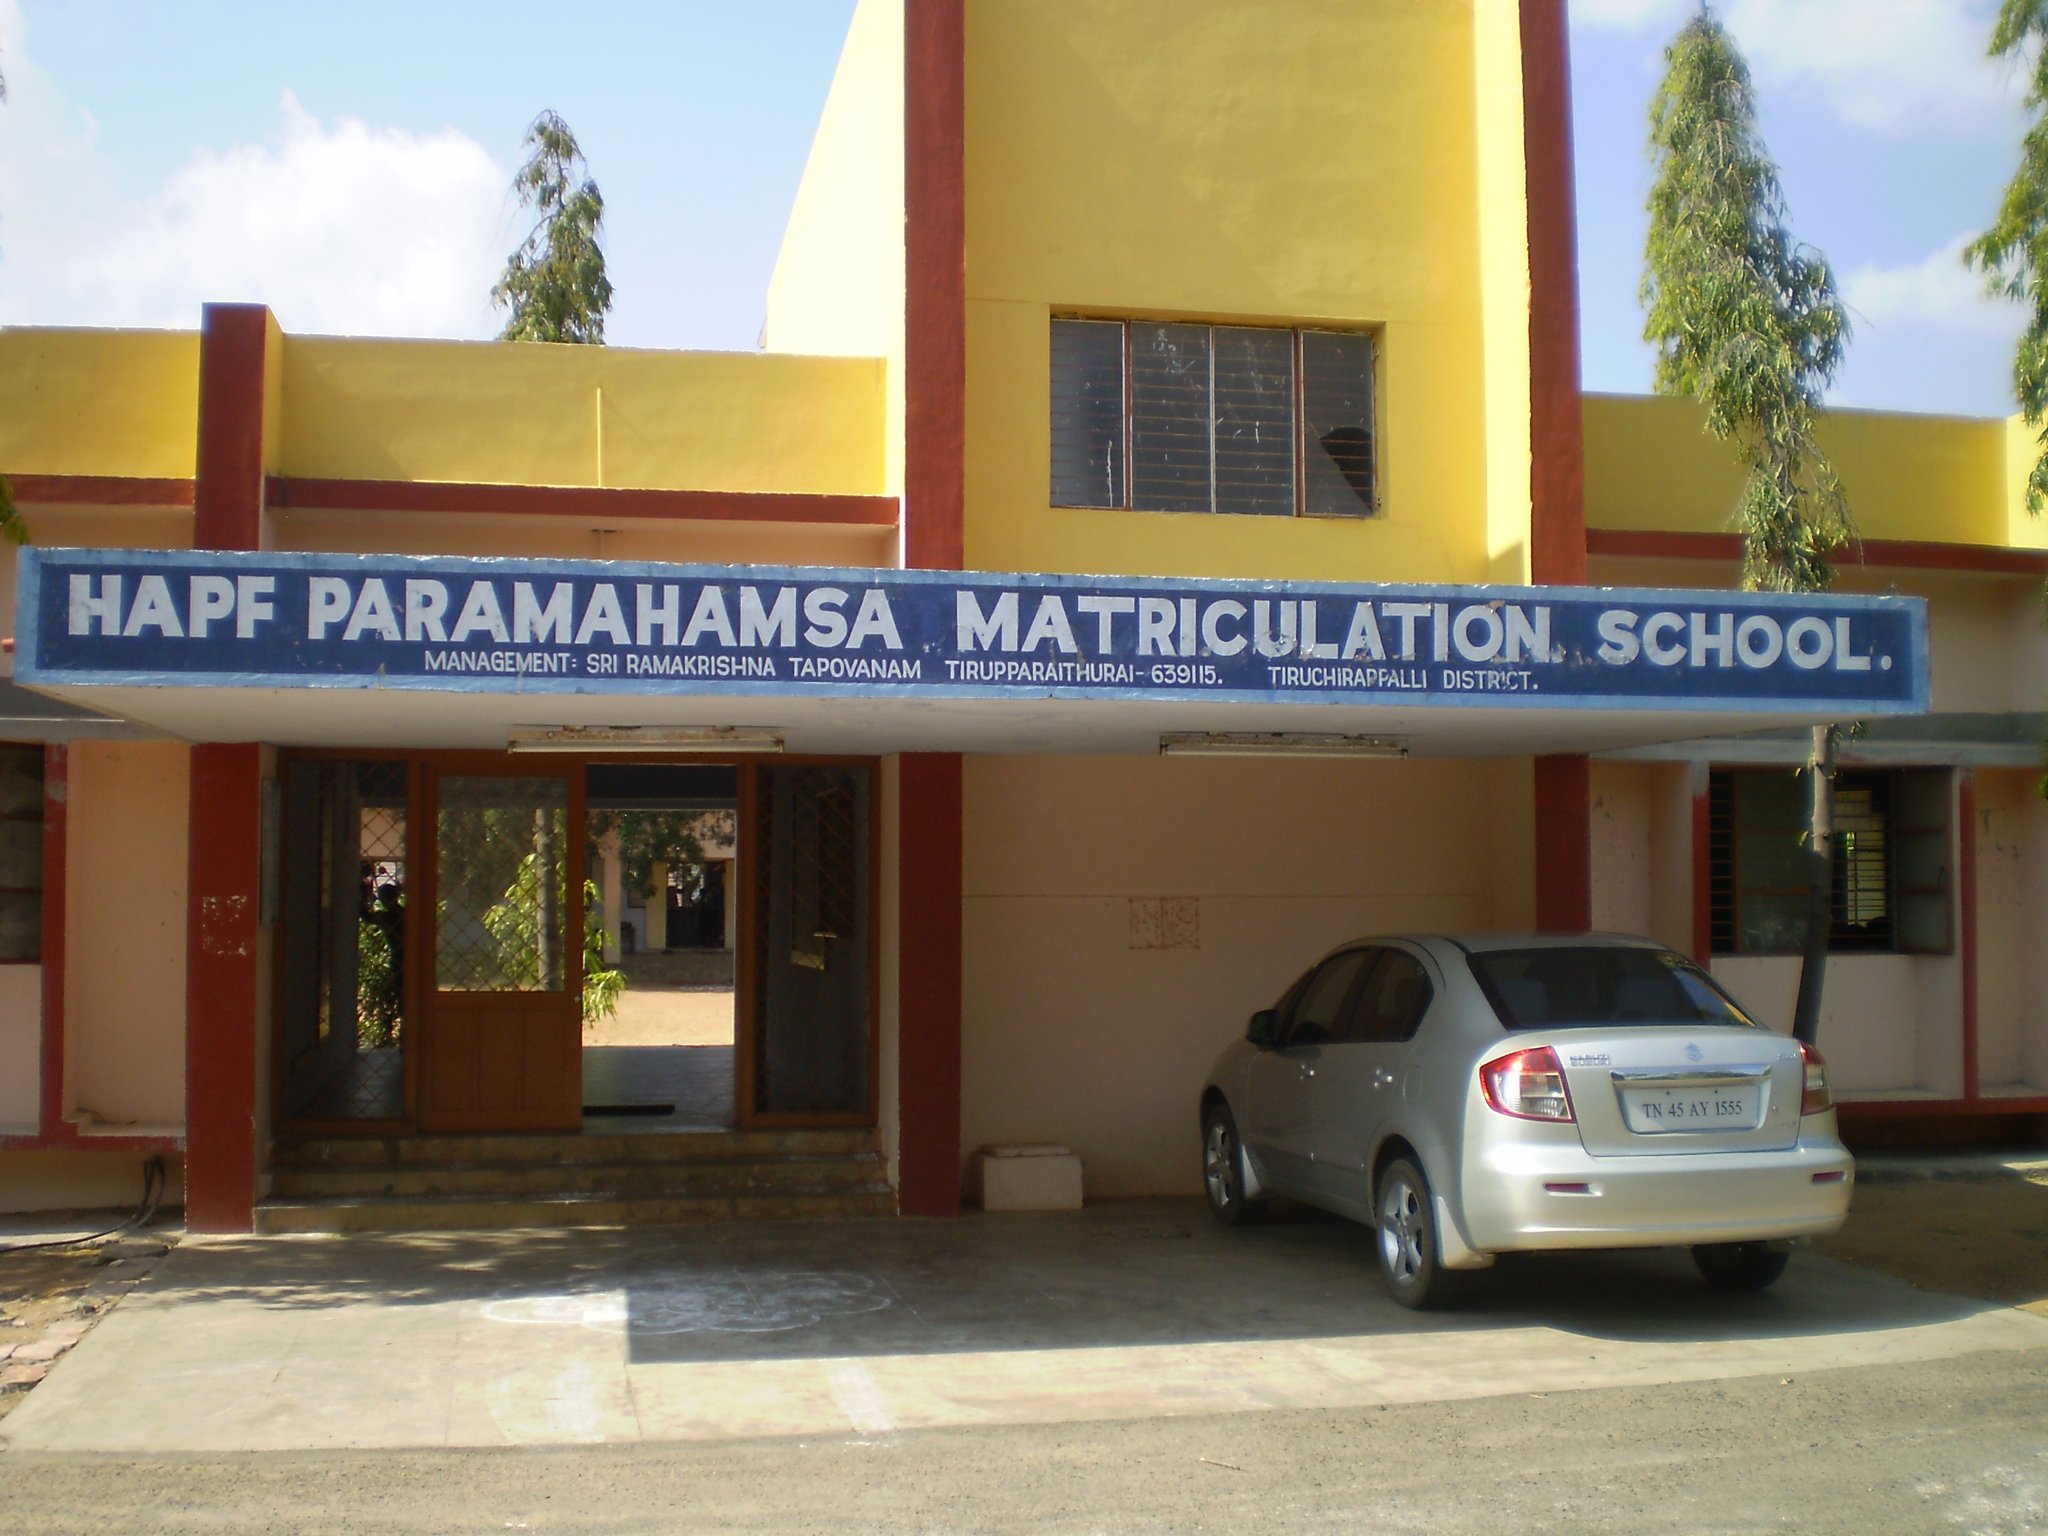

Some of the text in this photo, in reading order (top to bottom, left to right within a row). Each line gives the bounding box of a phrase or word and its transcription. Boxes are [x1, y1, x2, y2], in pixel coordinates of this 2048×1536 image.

[67, 573, 275, 638] HAPF
[307, 577, 903, 650] PARAMAHAMSA
[1597, 609, 1892, 673] SCHOOL.
[424, 650, 578, 674] MANAGEMENT:
[586, 653, 618, 675] SRI
[626, 654, 776, 677] RAMAKRISHNA
[788, 657, 922, 680] TAPOVANAM
[1443, 669, 1540, 691] DISTRICT.
[1642, 1100, 1743, 1119] TN 45 AY 1555
